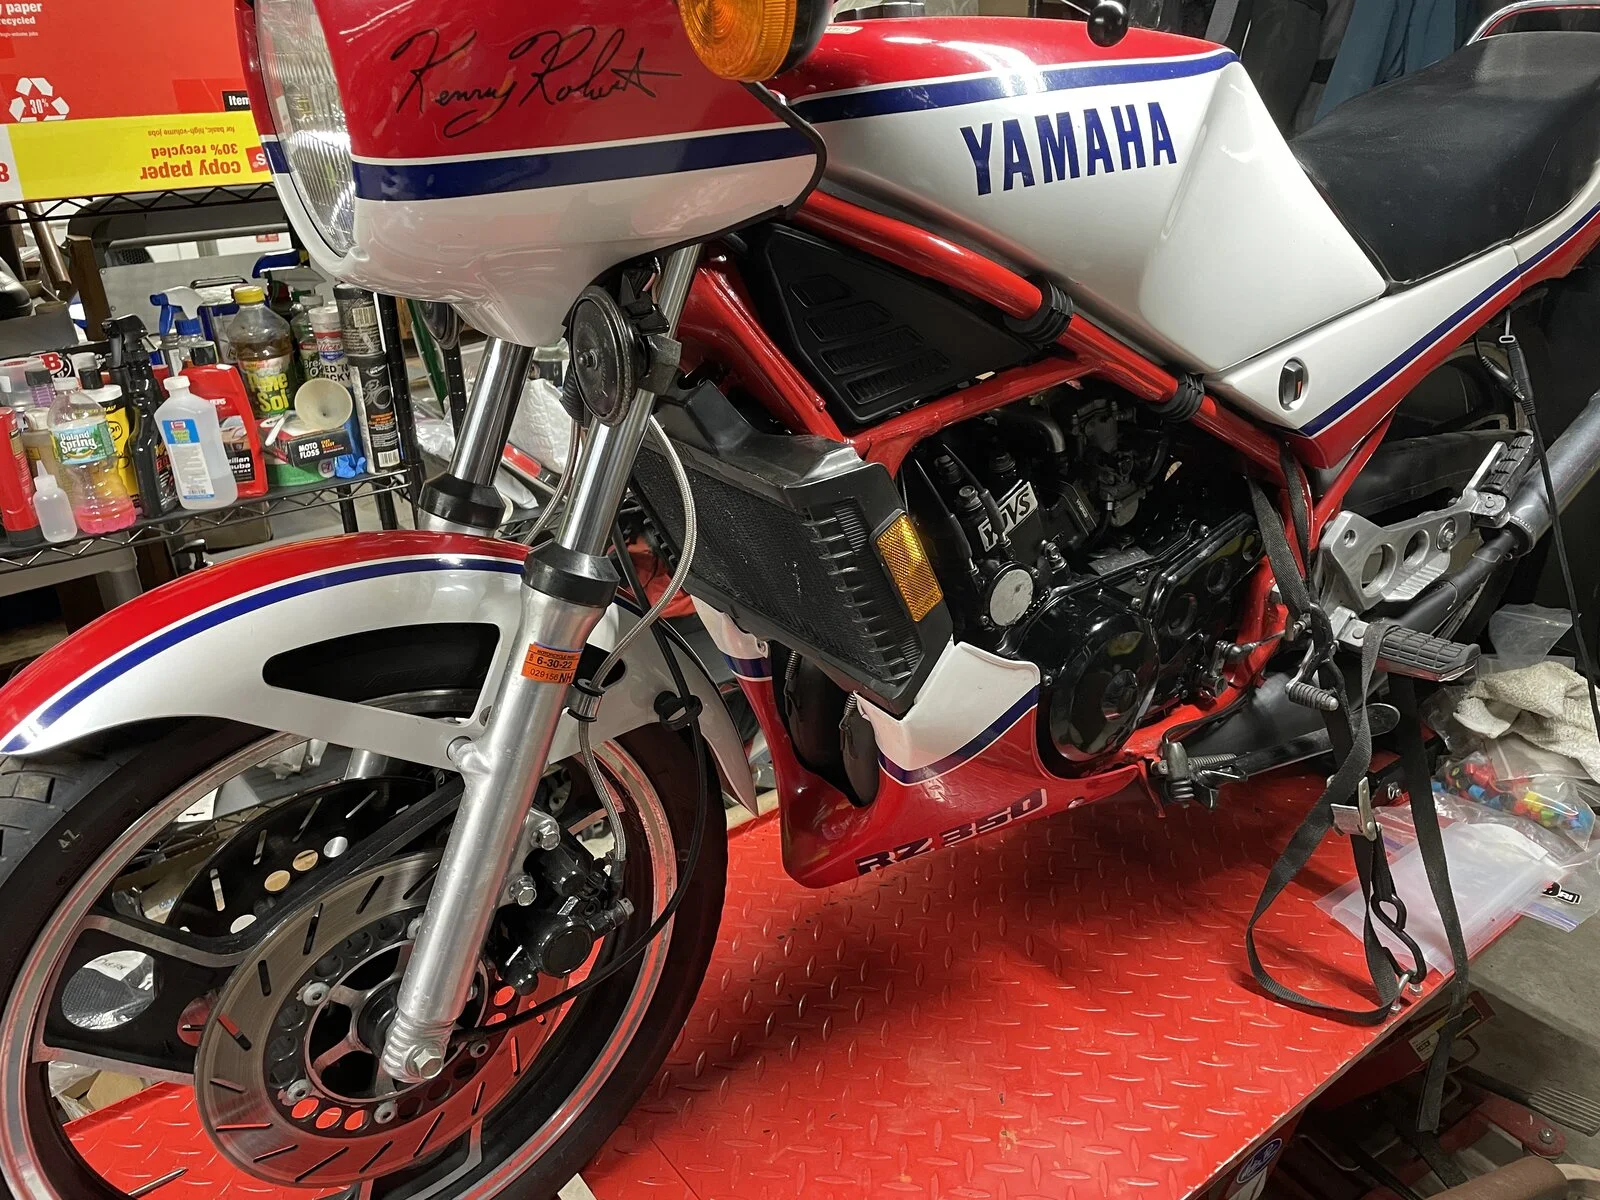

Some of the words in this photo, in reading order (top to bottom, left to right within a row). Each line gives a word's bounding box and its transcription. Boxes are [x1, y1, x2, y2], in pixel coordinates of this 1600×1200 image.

[5, 2, 42, 15] paper
[390, 28, 517, 138] Kenny
[30, 98, 49, 114] 30%
[147, 129, 163, 137] jobs
[163, 127, 205, 137] high-volume
[151, 144, 207, 159] recycled
[210, 143, 238, 155] 30%
[959, 101, 1177, 196] YAMAHA
[140, 160, 193, 180] paper
[199, 158, 241, 176] copy
[257, 388, 289, 412] Sol
[60, 430, 90, 441] Poland
[60, 438, 98, 454] Spring
[298, 442, 318, 452] MOTO
[299, 448, 320, 459] FLOSS
[537, 656, 573, 669] 6-30-22
[559, 672, 574, 683] NH
[855, 837, 935, 876] RZ
[938, 788, 1048, 848] 350
